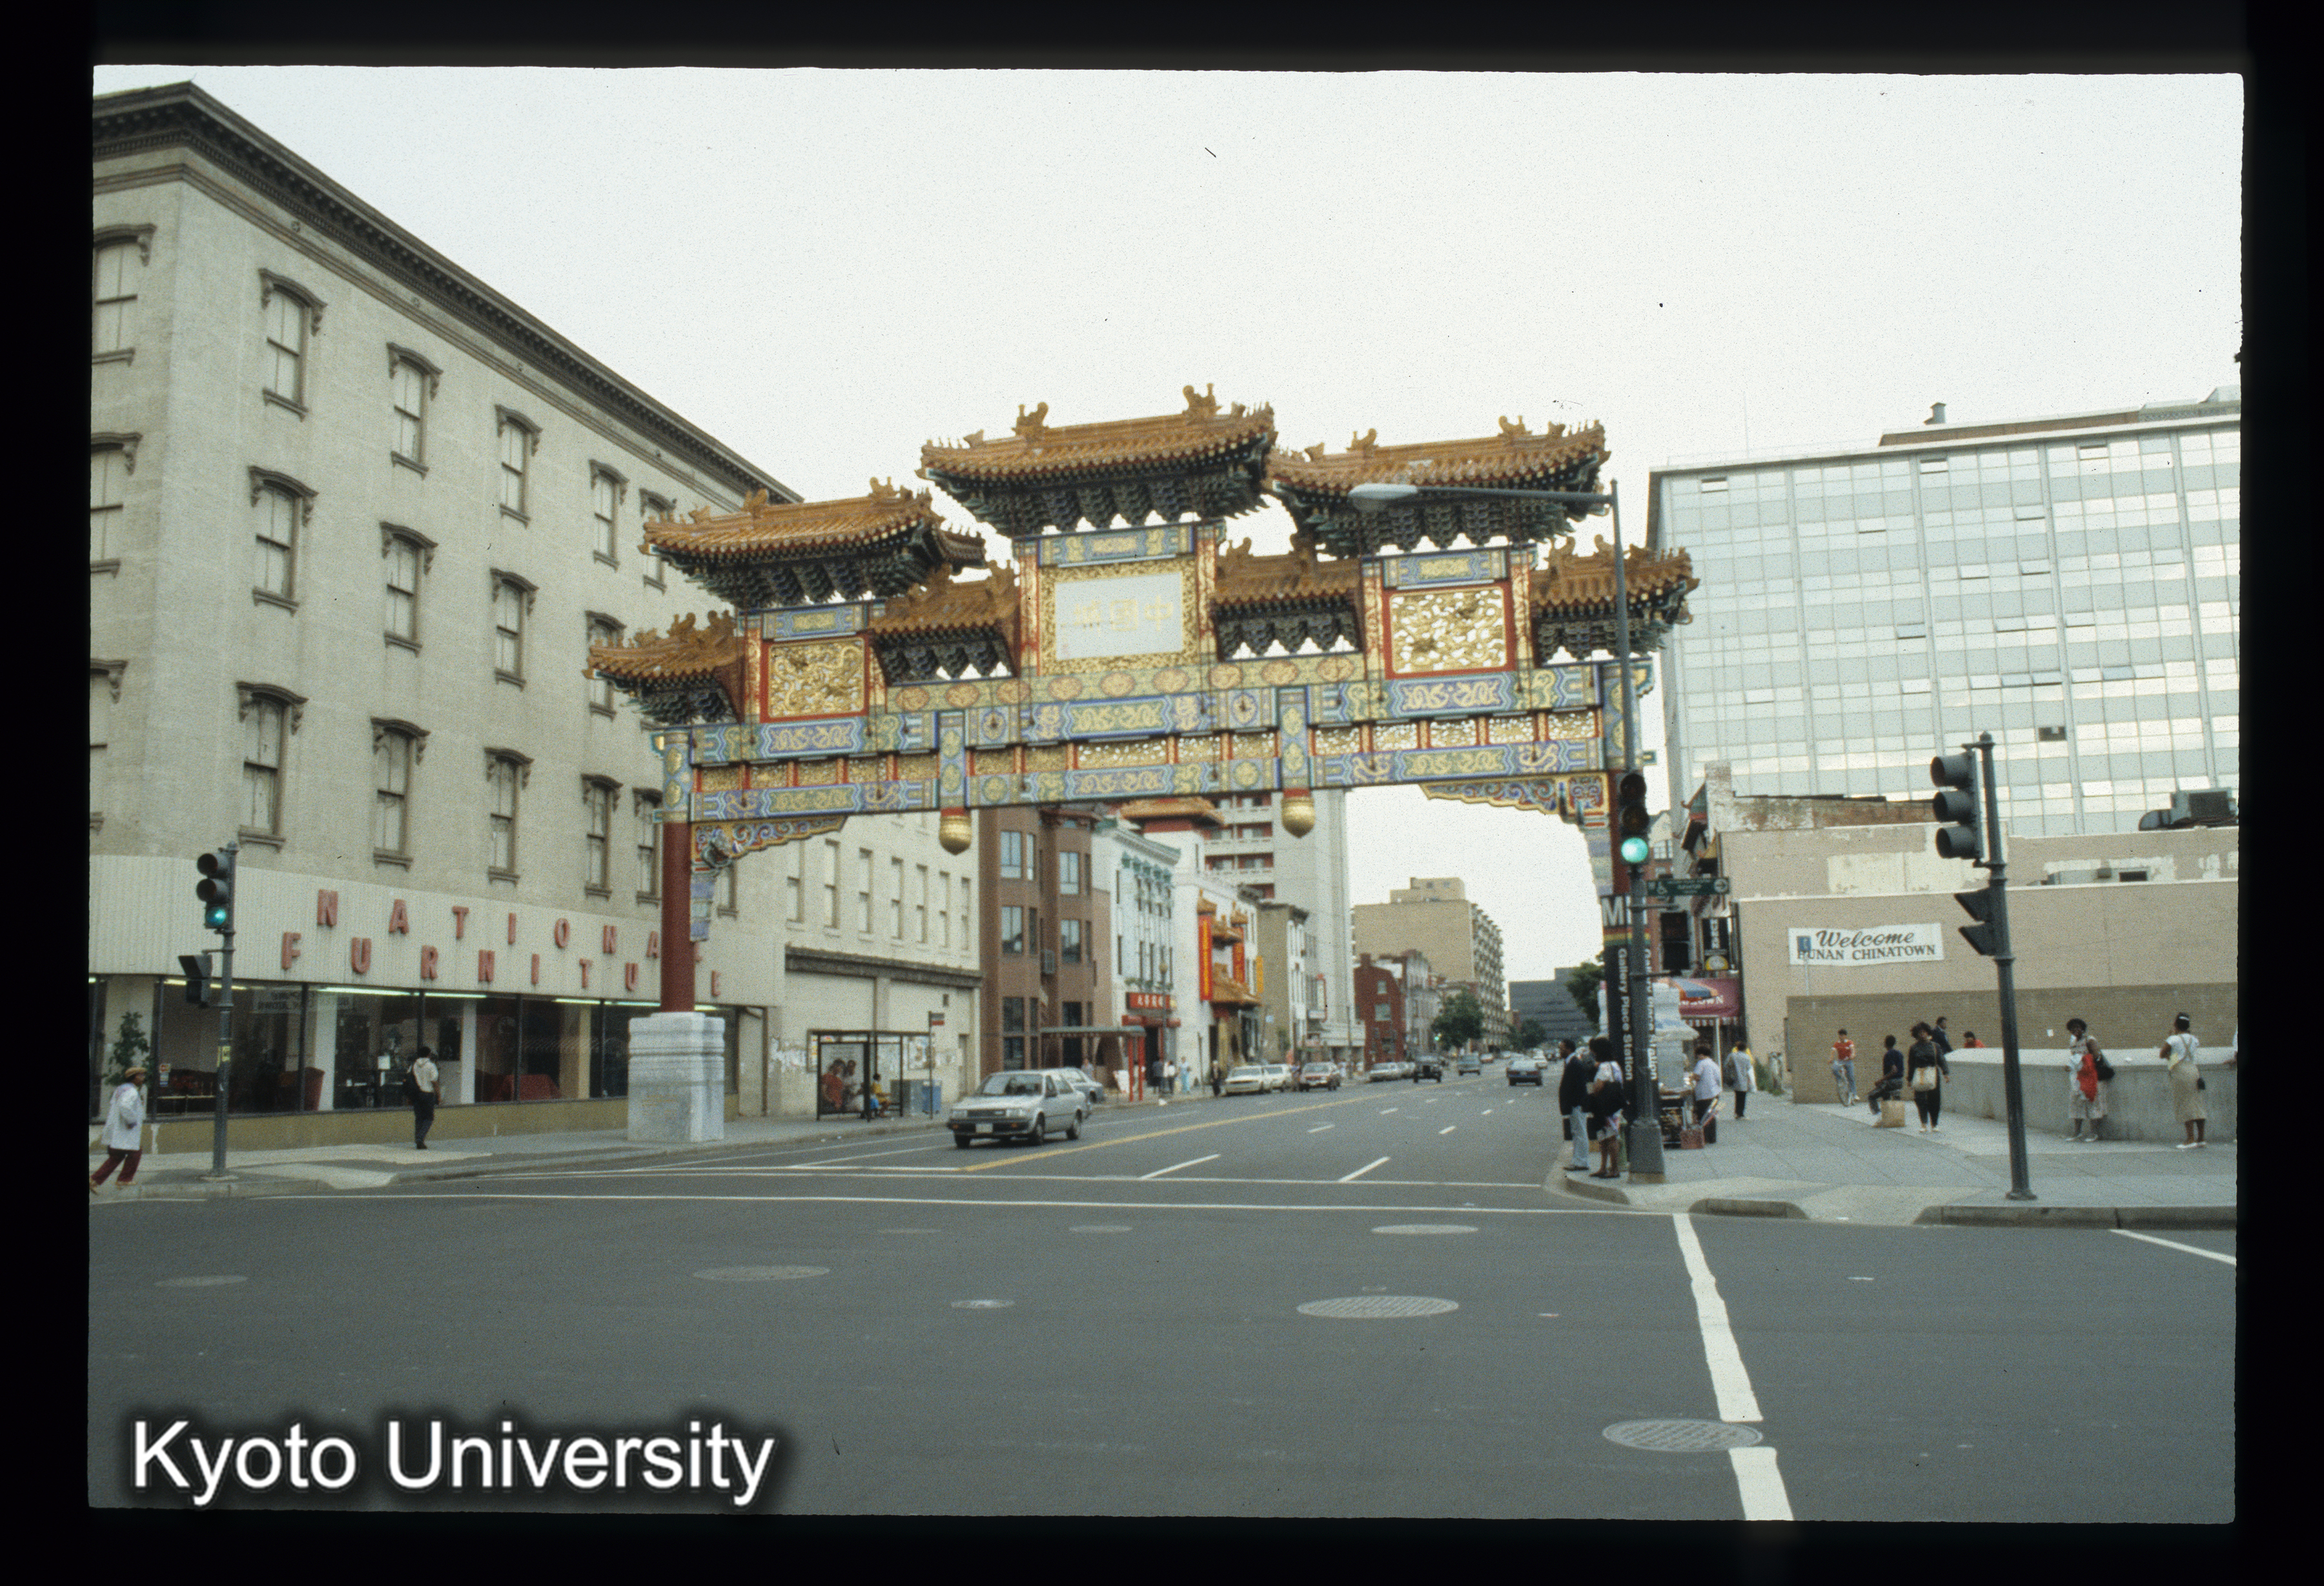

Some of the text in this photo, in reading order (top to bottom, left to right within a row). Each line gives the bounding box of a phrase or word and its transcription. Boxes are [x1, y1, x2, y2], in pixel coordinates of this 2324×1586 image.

[1797, 944, 1936, 961] HUNAN CHINATOWN
[1815, 930, 1915, 948] Welcome
[281, 931, 721, 997] FURNITUE
[1618, 948, 1634, 1081] Gallery Place Station
